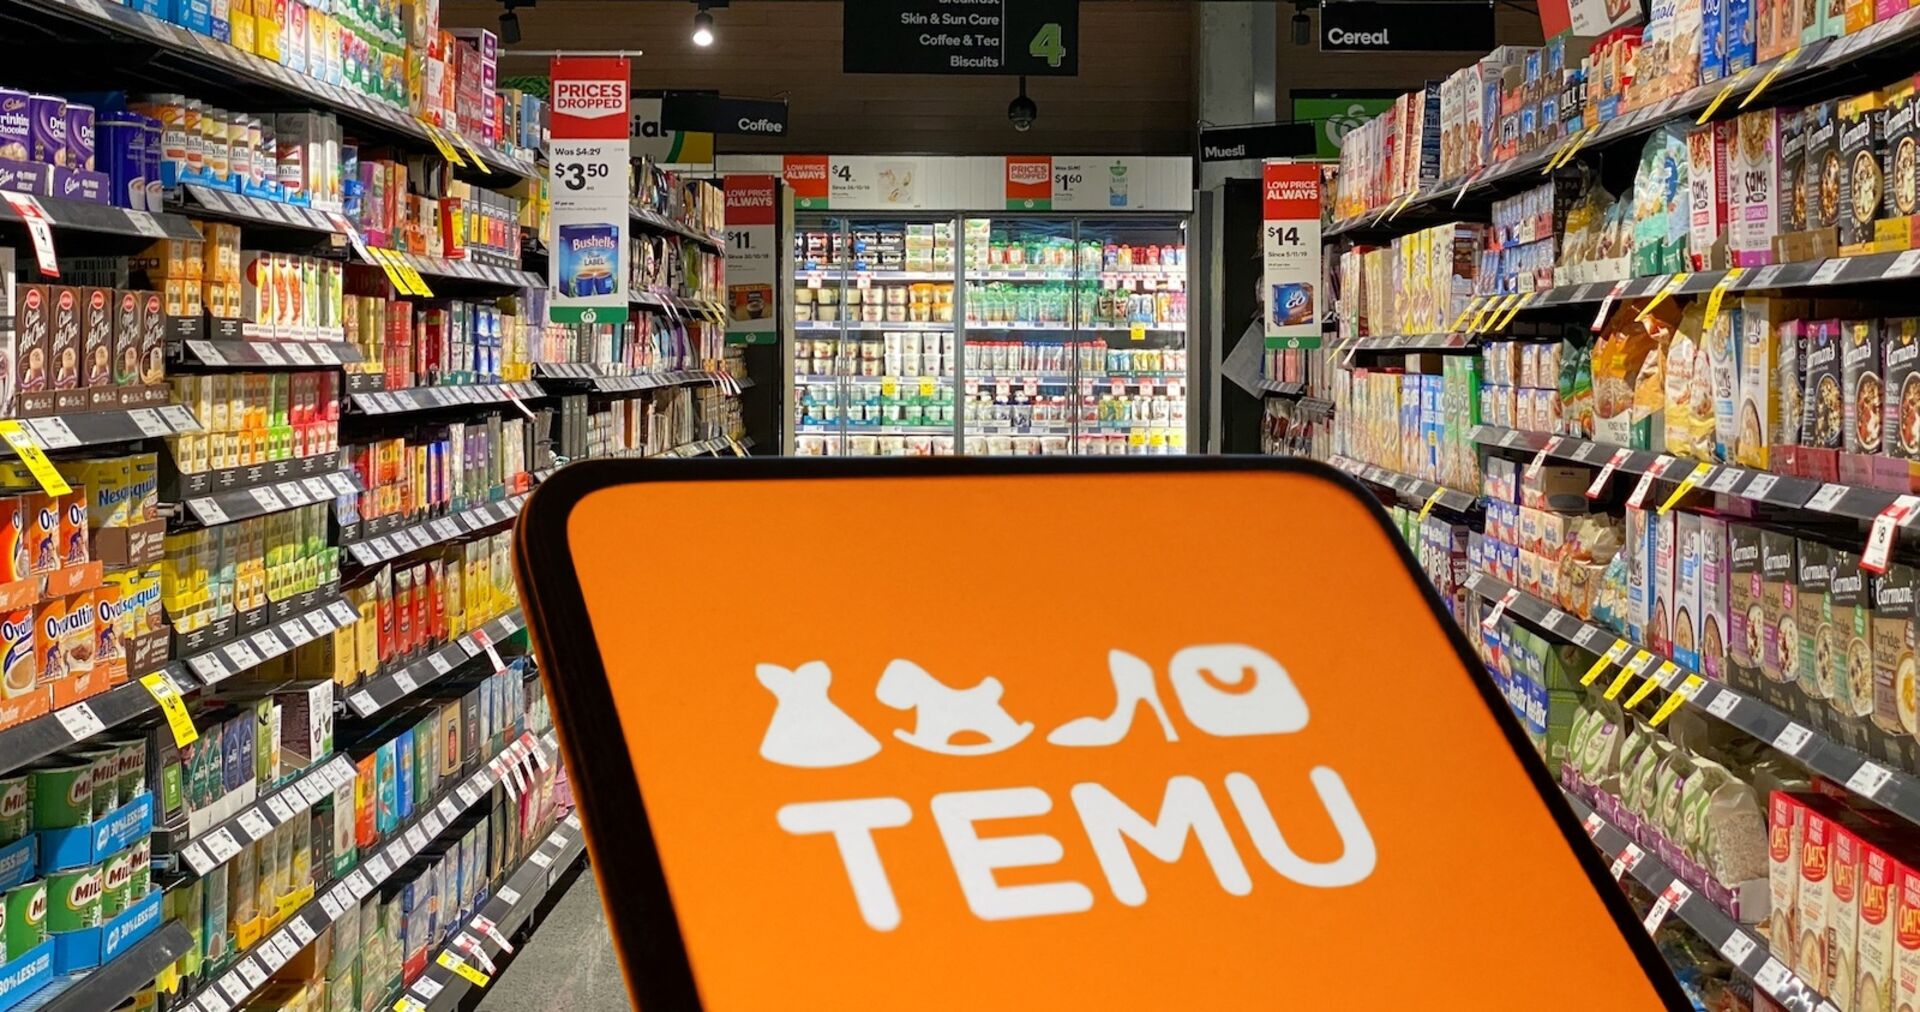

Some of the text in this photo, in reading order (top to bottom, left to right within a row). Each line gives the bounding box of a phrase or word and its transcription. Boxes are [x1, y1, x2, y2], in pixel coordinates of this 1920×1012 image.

[901, 12, 1000, 26] Skin & Sun Care
[919, 34, 1000, 46] Coffee & Tea
[1327, 27, 1390, 45] Cereal
[1029, 23, 1067, 68] 4
[951, 55, 999, 67] Biscuits
[558, 83, 623, 98] PRICES
[557, 98, 623, 109] DROPPED
[738, 117, 783, 133] Coffee
[555, 147, 574, 156] Was
[1204, 144, 1246, 158] Muesli
[803, 163, 826, 171] PRICE
[832, 165, 852, 182] $4
[1010, 165, 1048, 174] PRICES
[786, 171, 827, 180] ALWAYS
[1267, 180, 1317, 190] LOW PRICE
[727, 188, 773, 198] LOW PRICE
[1266, 189, 1318, 200] ALWAYS
[727, 196, 774, 207] ALWAYS
[573, 235, 616, 251] Bushells
[728, 231, 750, 249] $11
[1268, 226, 1300, 247] $14
[1772, 824, 1788, 850] OATS
[776, 766, 1377, 932] TEMU
[1804, 842, 1826, 869] OATS
[1834, 859, 1853, 888] OATS
[1862, 881, 1886, 910] OATS
[16, 963, 37, 984] LESS
